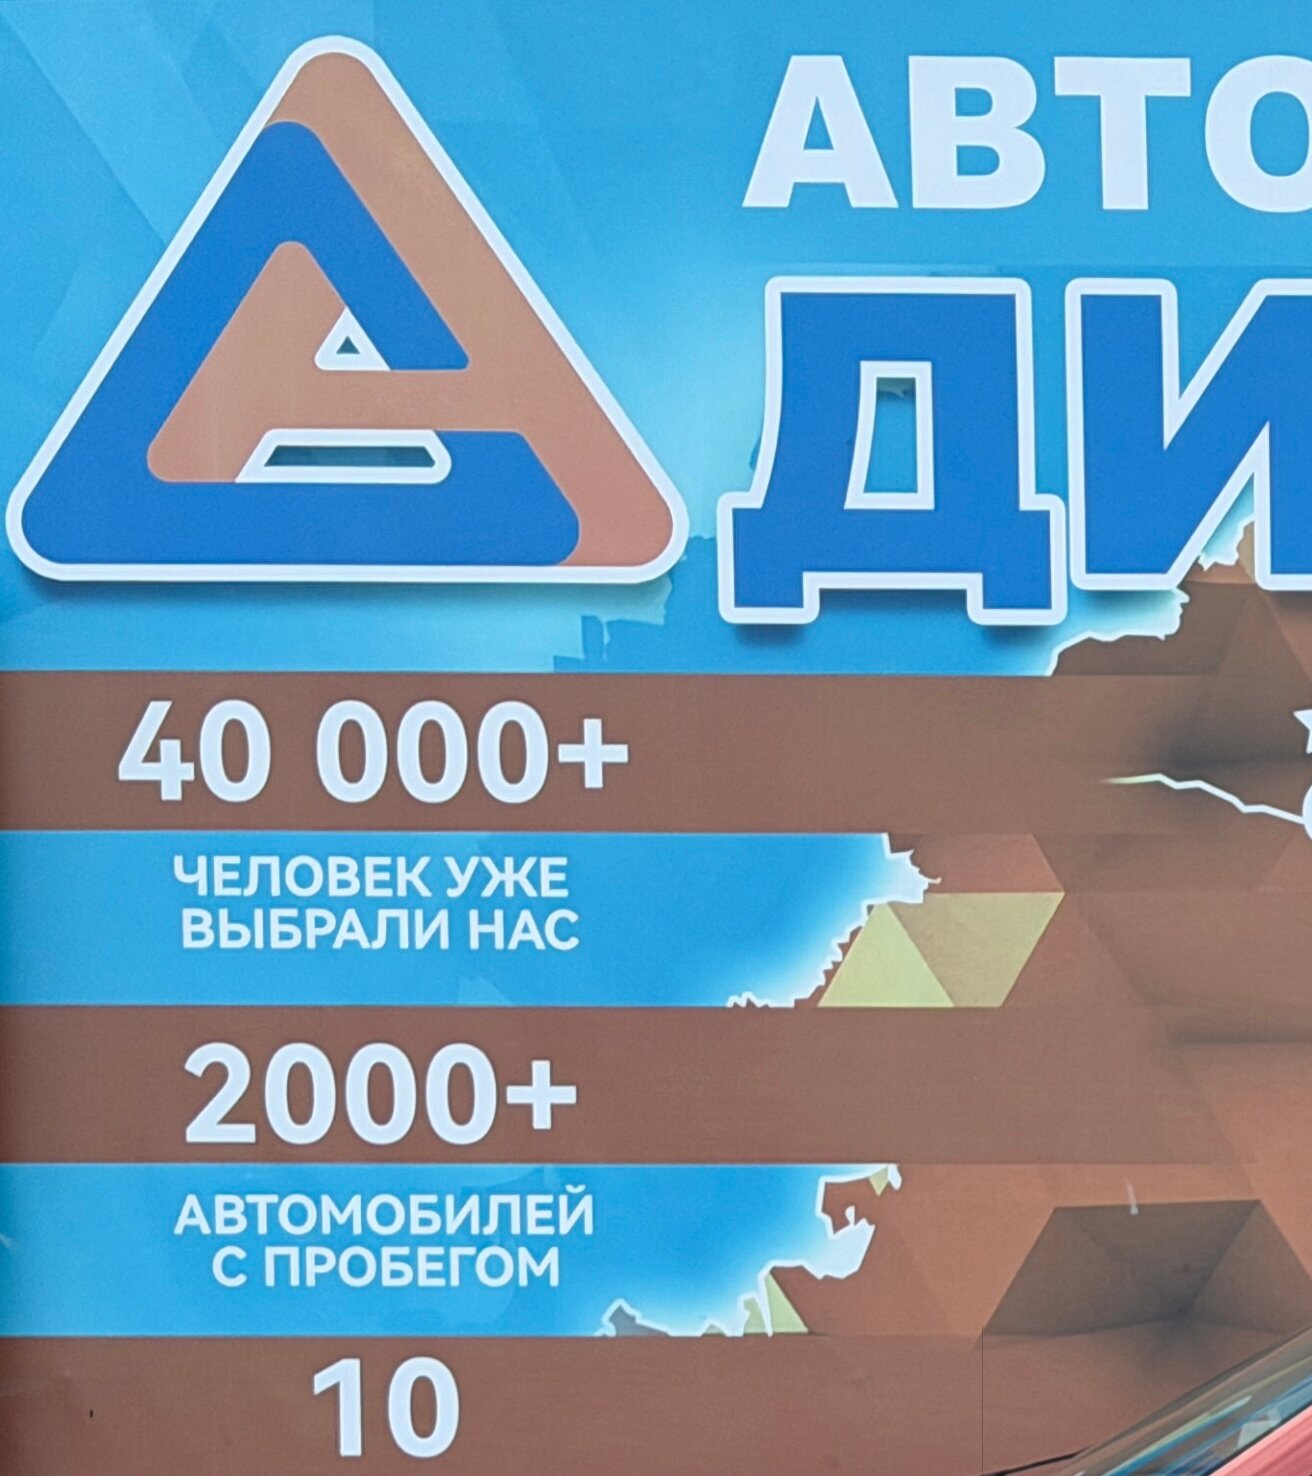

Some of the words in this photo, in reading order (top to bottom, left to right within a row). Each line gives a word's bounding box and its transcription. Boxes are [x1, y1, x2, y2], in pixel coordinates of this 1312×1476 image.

[118, 700, 271, 802] 40
[316, 700, 629, 803] 000+
[173, 855, 432, 898] ЧЕЛОВЕК
[445, 856, 569, 898] УЖЕ
[182, 908, 450, 950] ВЫБРАЛИ
[469, 909, 580, 951] НАС
[184, 1042, 577, 1145] 2000+
[174, 1185, 594, 1236] АВТОМОБИЛЕЙ
[212, 1246, 246, 1288] С
[265, 1246, 559, 1288] ПРОБЕГОМ
[313, 1356, 460, 1458] 10
